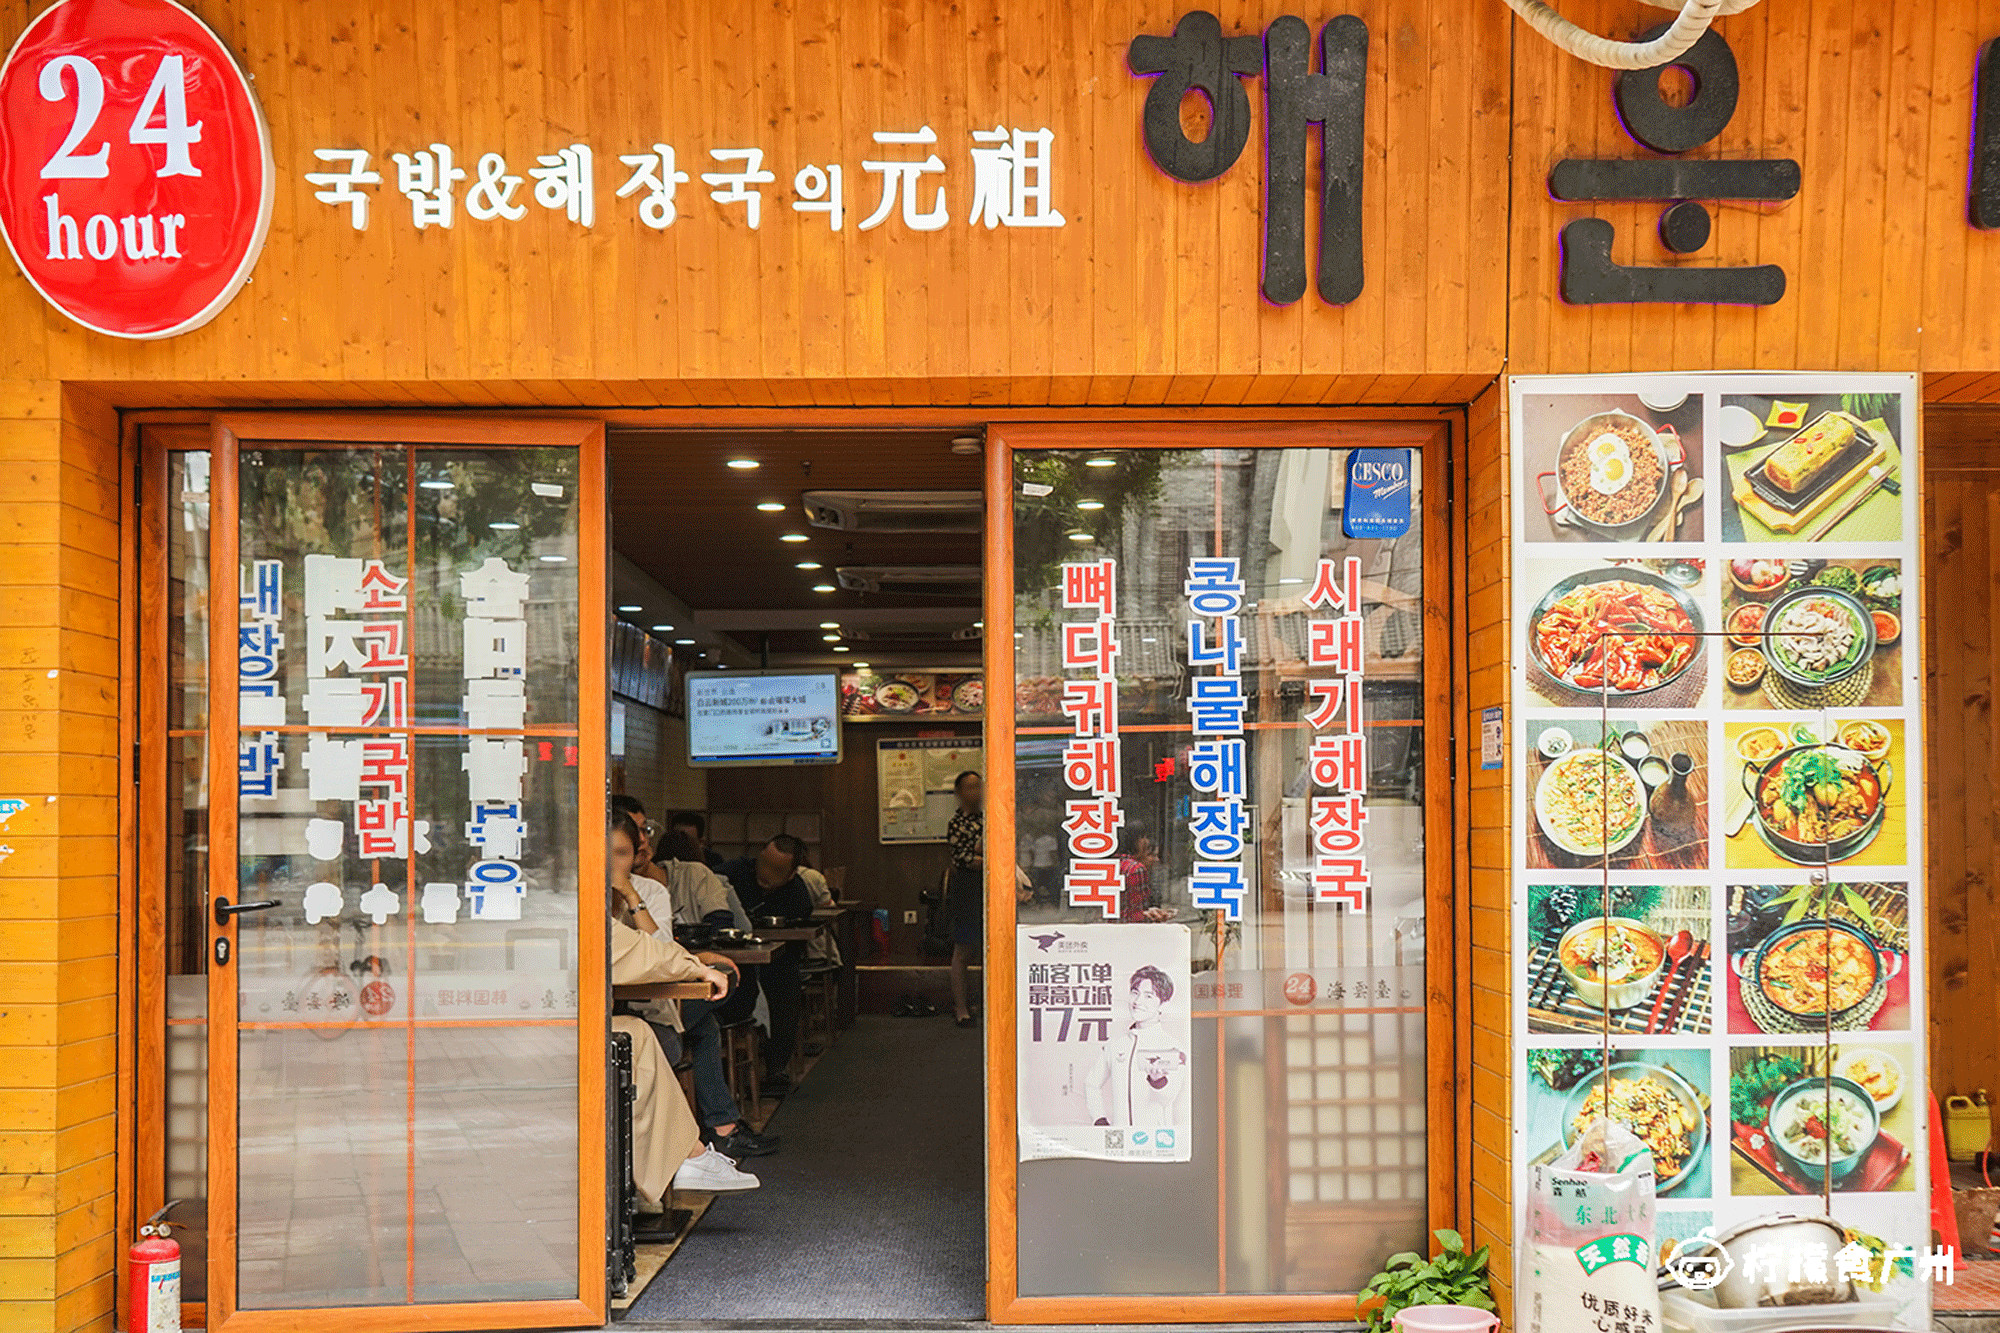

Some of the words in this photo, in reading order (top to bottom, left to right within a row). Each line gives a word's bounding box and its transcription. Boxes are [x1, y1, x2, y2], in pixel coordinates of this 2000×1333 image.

[38, 54, 203, 180] 24
[1127, 9, 2000, 305] 해운
[45, 192, 187, 261] hour
[1352, 462, 1403, 480] CESCO
[240, 561, 284, 799] 내장밥
[360, 562, 408, 858] 소고기국밥
[1061, 559, 1125, 919] 뼈다귀해장국
[1185, 557, 1248, 921] 콩나물해장국
[1303, 557, 1370, 915] 시래기해장국
[1029, 963, 1112, 984] 新客下单
[1029, 985, 1112, 1006] 最高立减
[1286, 977, 1312, 994] 24
[1029, 1007, 1113, 1042] 17元
[1581, 1291, 1653, 1325] 优质好米
